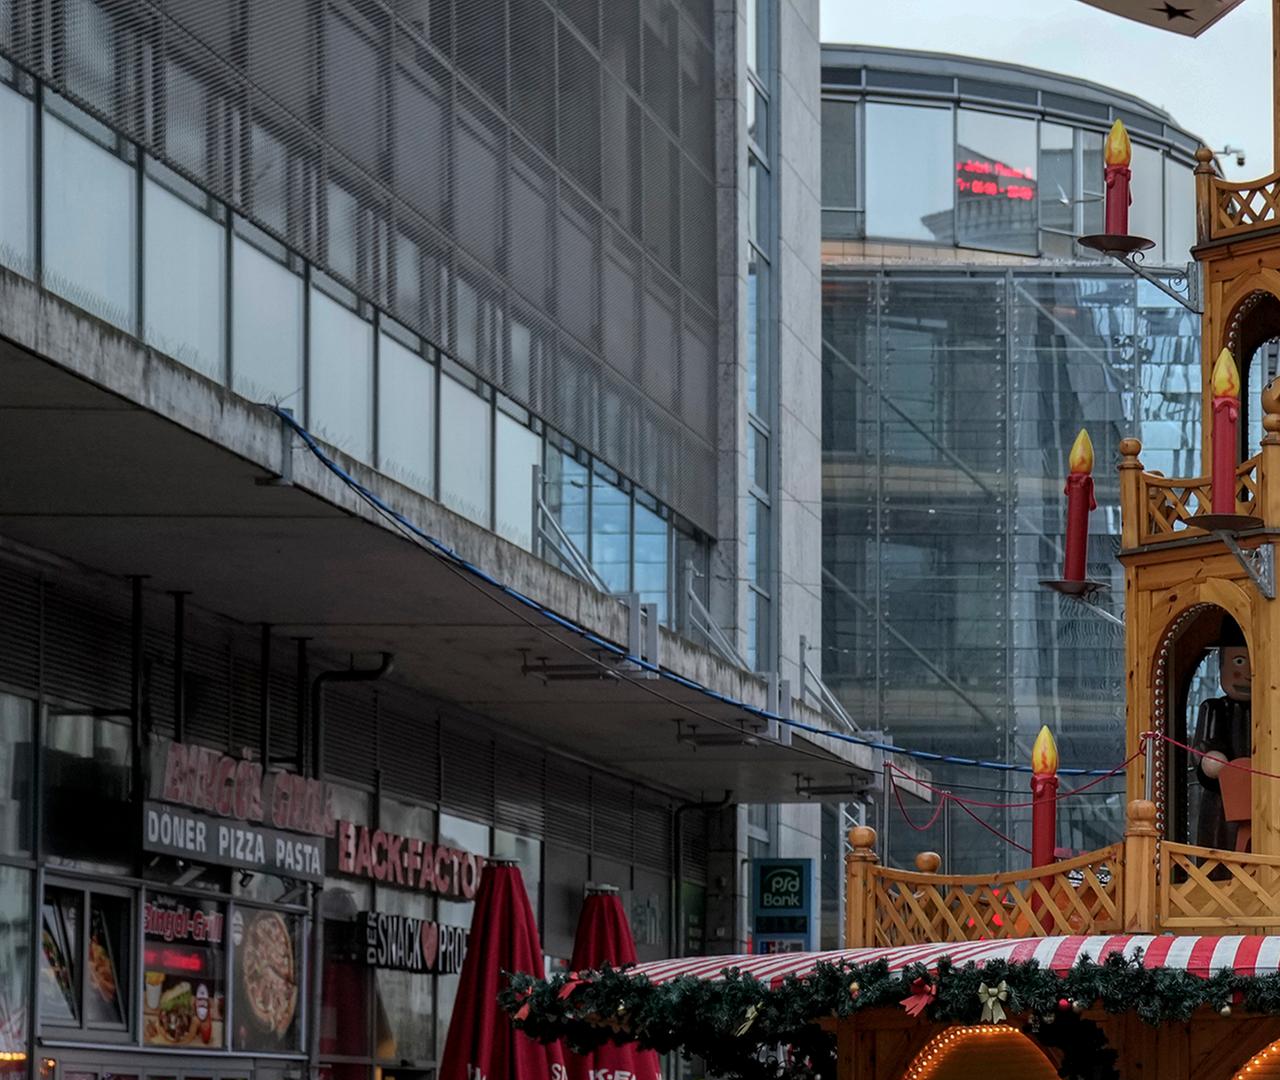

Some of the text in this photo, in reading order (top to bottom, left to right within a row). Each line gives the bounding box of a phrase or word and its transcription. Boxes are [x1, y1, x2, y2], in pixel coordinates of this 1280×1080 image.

[147, 804, 322, 875] DÖNER PIZZA PASTA
[763, 893, 801, 907] Bank
[377, 913, 422, 970] SNACK
